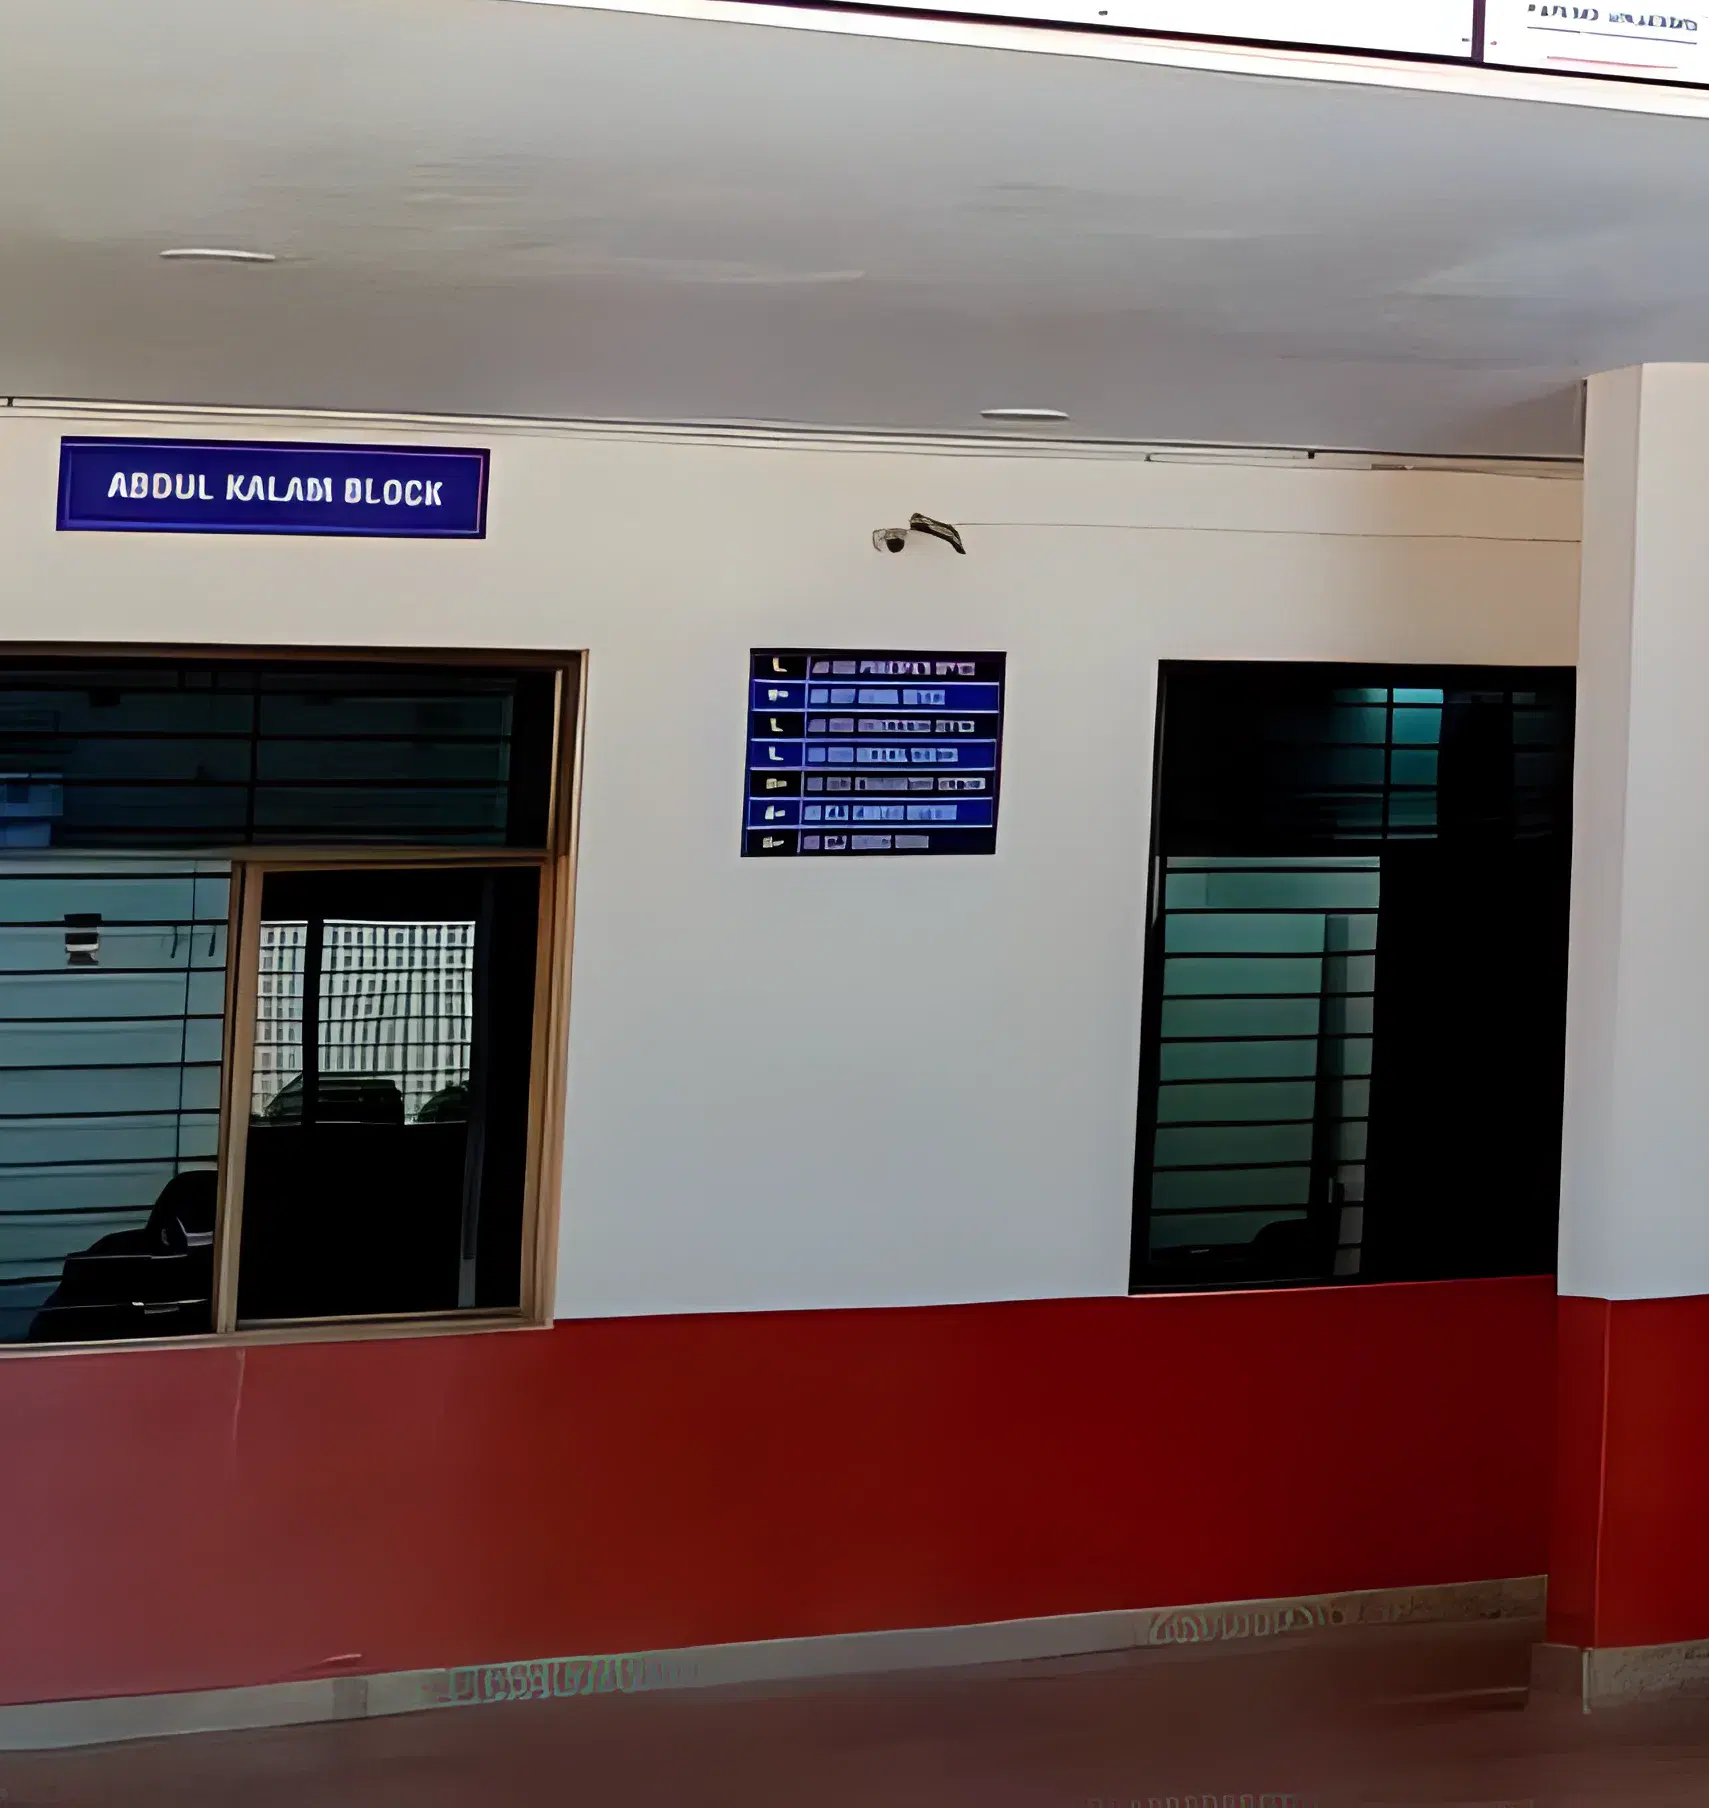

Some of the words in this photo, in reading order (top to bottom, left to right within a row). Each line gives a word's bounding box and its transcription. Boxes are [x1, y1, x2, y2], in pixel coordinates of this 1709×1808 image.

[107, 471, 214, 501] ABDUL
[226, 474, 333, 503] KALAM
[344, 477, 443, 506] BLOCK
